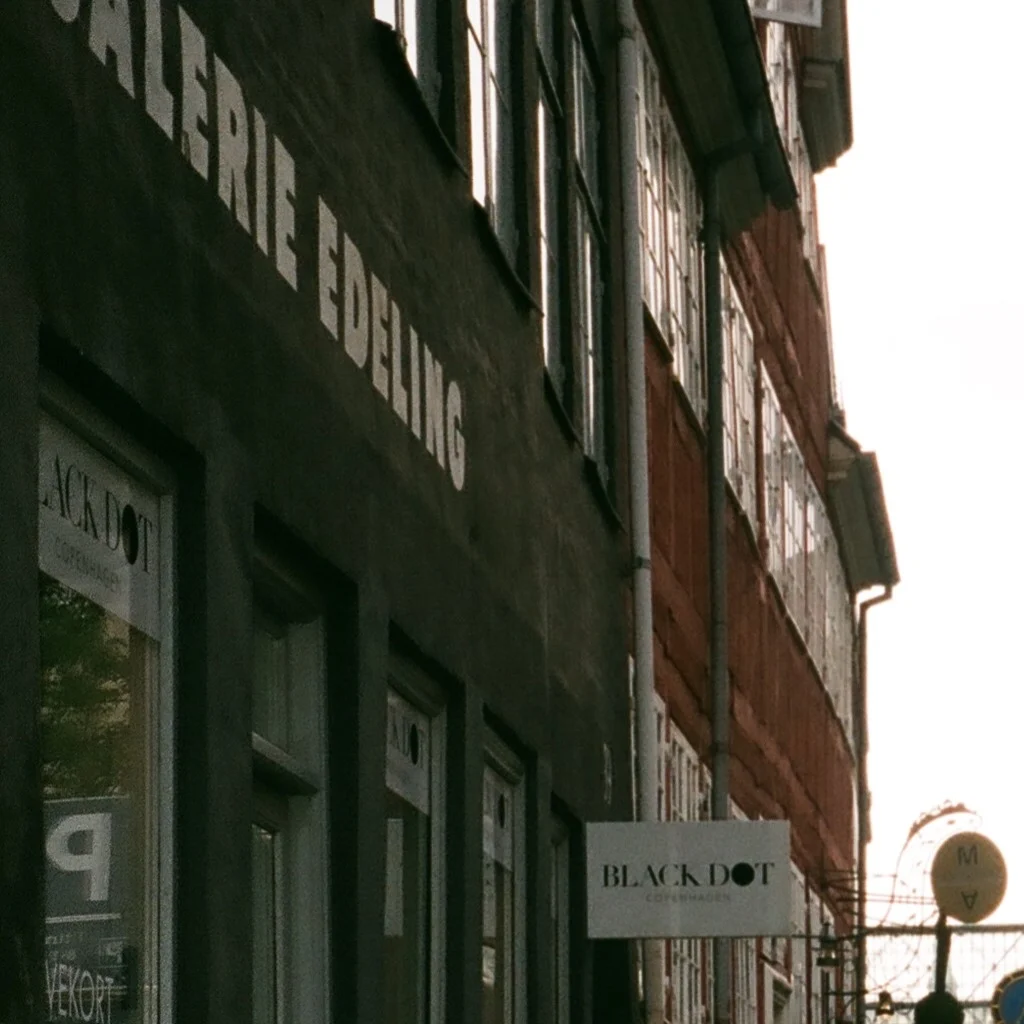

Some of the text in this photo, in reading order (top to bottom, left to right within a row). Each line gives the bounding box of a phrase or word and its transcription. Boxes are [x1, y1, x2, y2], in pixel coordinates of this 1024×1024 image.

[54, 0, 466, 491] ALERIE EDELING
[43, 453, 154, 574] ACK DOT
[602, 862, 775, 888] BLACK DOT
[957, 845, 978, 866] M
